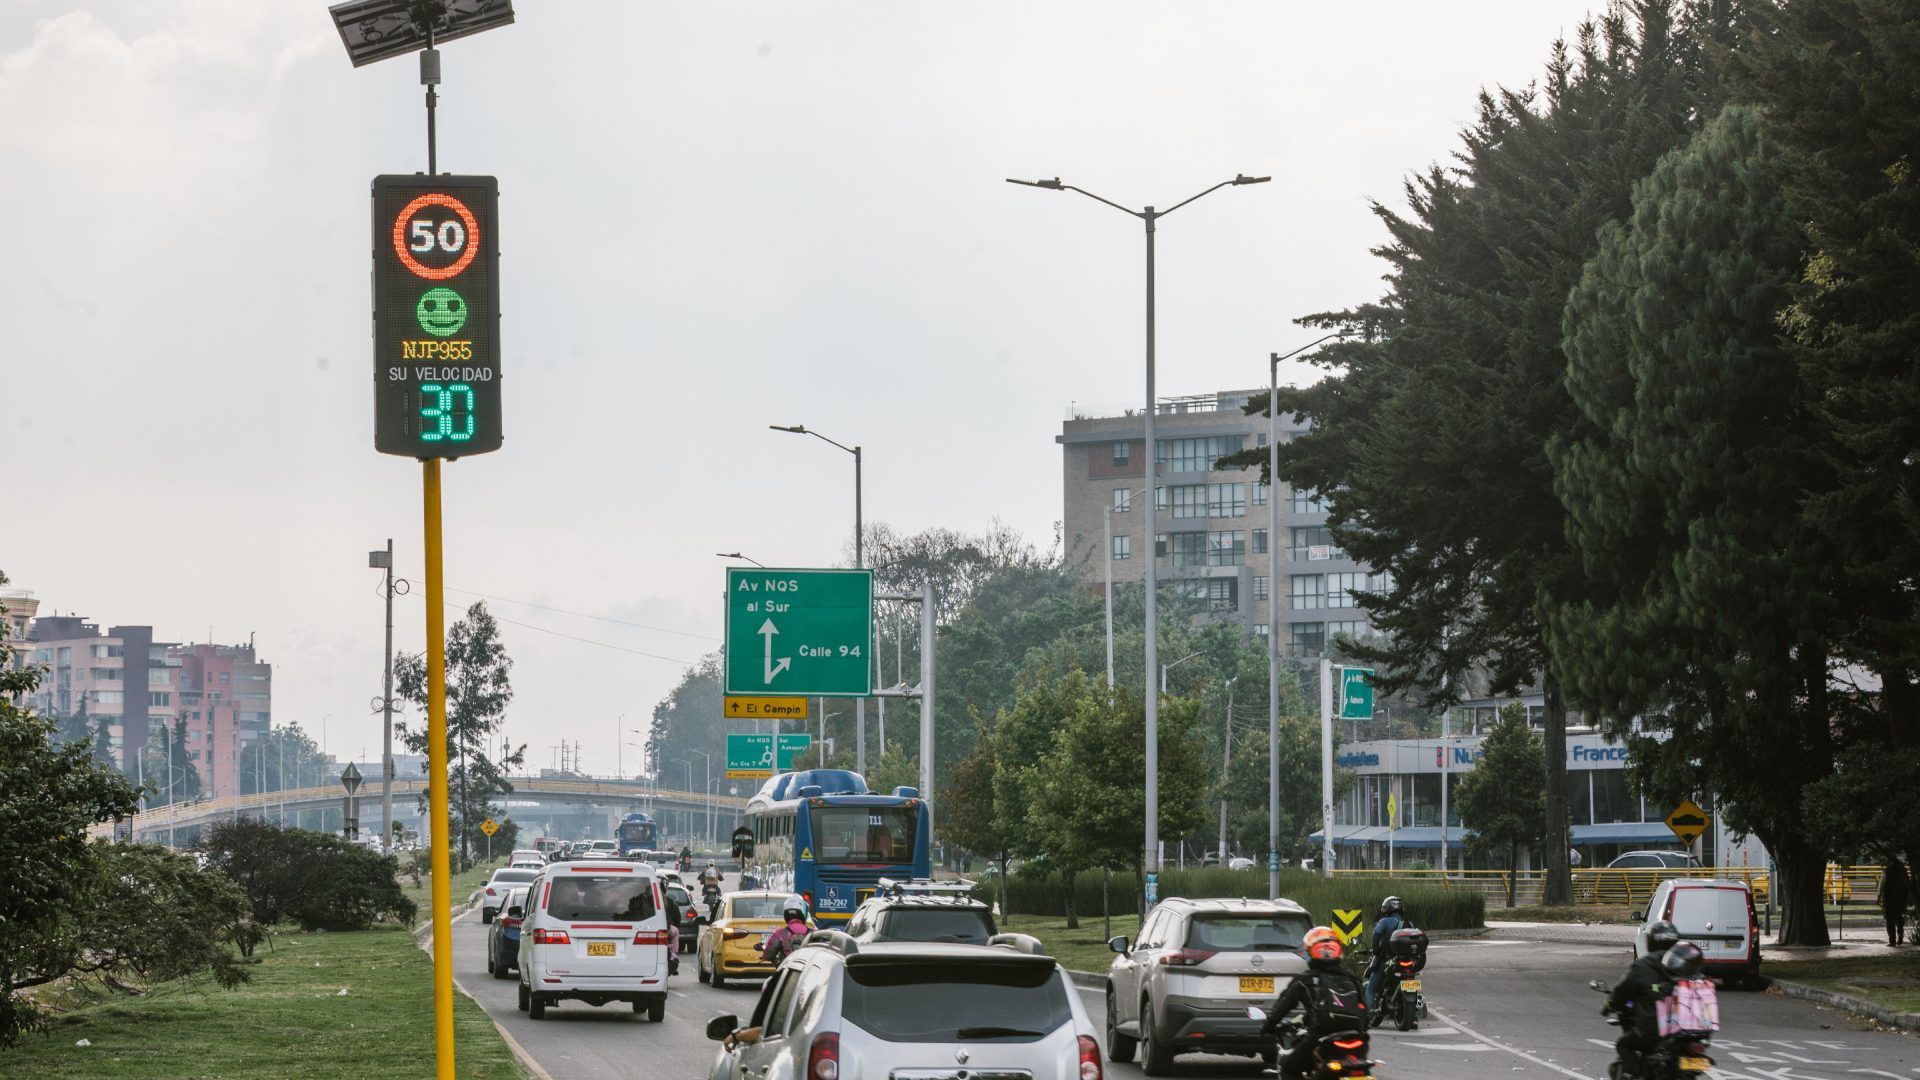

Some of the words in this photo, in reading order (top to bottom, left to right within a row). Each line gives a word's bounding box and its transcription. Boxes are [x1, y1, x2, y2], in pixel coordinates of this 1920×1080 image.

[411, 220, 465, 252] 50
[402, 340, 473, 360] NJP955
[389, 367, 408, 381] SU
[415, 367, 493, 382] VELOCIDAD
[421, 384, 475, 441] 30
[738, 579, 759, 591] Av
[765, 579, 799, 592] NQS
[746, 601, 758, 612] al
[765, 600, 790, 612] Sur
[799, 645, 832, 657] Calle
[839, 645, 861, 657] 94
[747, 704, 757, 713] El
[1573, 745, 1628, 761] France
[869, 815, 882, 825] T11
[1728, 1052, 1851, 1063] AL
